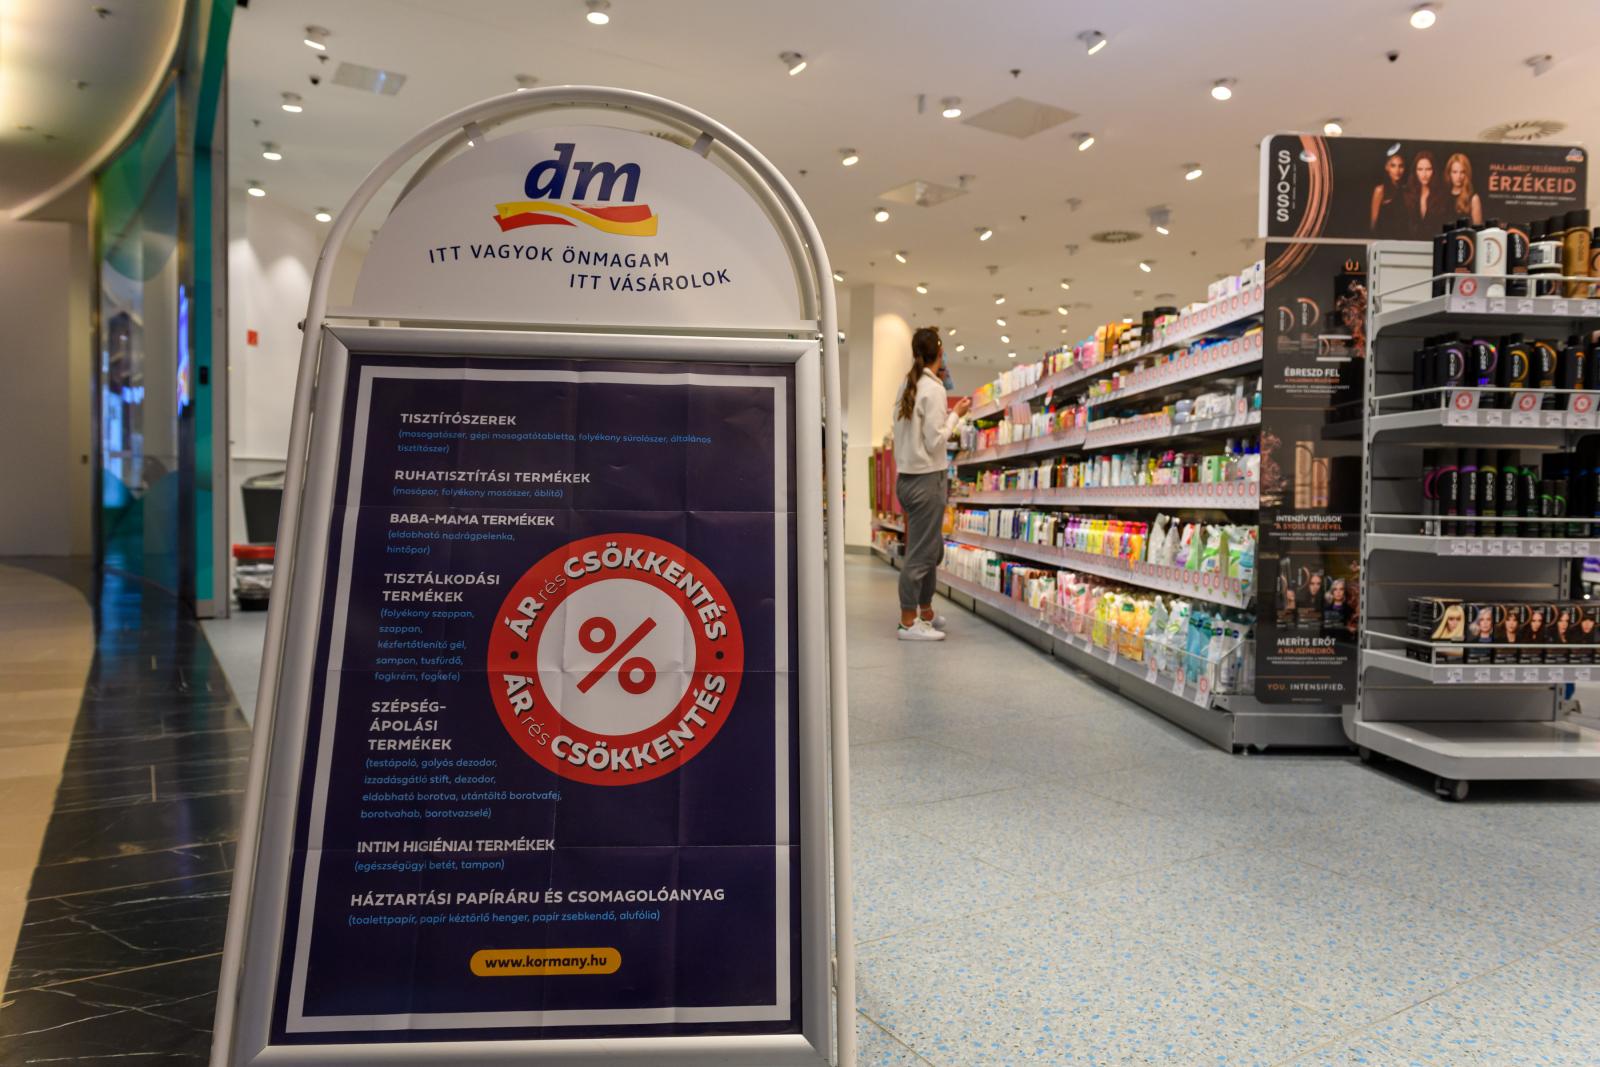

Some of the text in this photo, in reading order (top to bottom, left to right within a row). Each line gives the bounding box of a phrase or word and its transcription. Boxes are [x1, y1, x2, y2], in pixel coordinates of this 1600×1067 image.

[523, 143, 642, 203] dm
[1488, 171, 1577, 194] ÉRZÉKEID
[429, 244, 670, 268] ITT VAGYOK ÖNMAGAM
[569, 268, 731, 293] ITT VÁSÁROLOK
[1284, 365, 1341, 377] ÉBRESZD FEL
[399, 411, 518, 426] TISZTÍTÓSZEREK
[470, 432, 490, 443] gépi
[578, 432, 621, 443] folyékony
[670, 434, 712, 444] általános
[394, 468, 591, 483] RUHATISZTÍTÁSI TERMÉKEK
[441, 486, 485, 498] folyékony
[389, 513, 555, 526] BABA-MAMA TERMÉKEK
[442, 531, 516, 543] nadrágpelenka,
[386, 544, 431, 556] hintőpor)
[384, 571, 501, 585] TISZTÁLKODÁSI
[382, 588, 464, 603] TERMÉKEK
[380, 608, 475, 620] (folyékony szappan,
[378, 625, 423, 635] szappan,
[449, 641, 467, 651] gél,
[375, 657, 419, 666] sampon,
[374, 671, 461, 683] fogkrém, fogkefe)
[371, 698, 447, 713] SZÉPSÉG-
[369, 717, 438, 732] ÁPOLÁSI
[368, 736, 453, 751] TERMÉKEK
[365, 757, 498, 769] (testápoló, golyós dezodor,
[363, 774, 497, 786] izzadásgátló stift, dezodor,
[361, 790, 562, 802] eldobható borotva, utántöltő borotvafej,
[360, 807, 492, 820] borotvahab, borotvazselé)
[356, 836, 556, 853] INTIM HIGIÉNIAI TERMÉKEK
[354, 858, 505, 873] (egészségügyi betét, tampon)
[350, 886, 726, 907] HÁZTARTÁSI PAPÍRÁRU ÉS CSOMAGOLÓANYAG
[348, 909, 661, 927] (toalettpapír, papír kéztörlő henger, papír zsebkendő, alufólia)
[485, 953, 608, 970] www.kormany.hu
